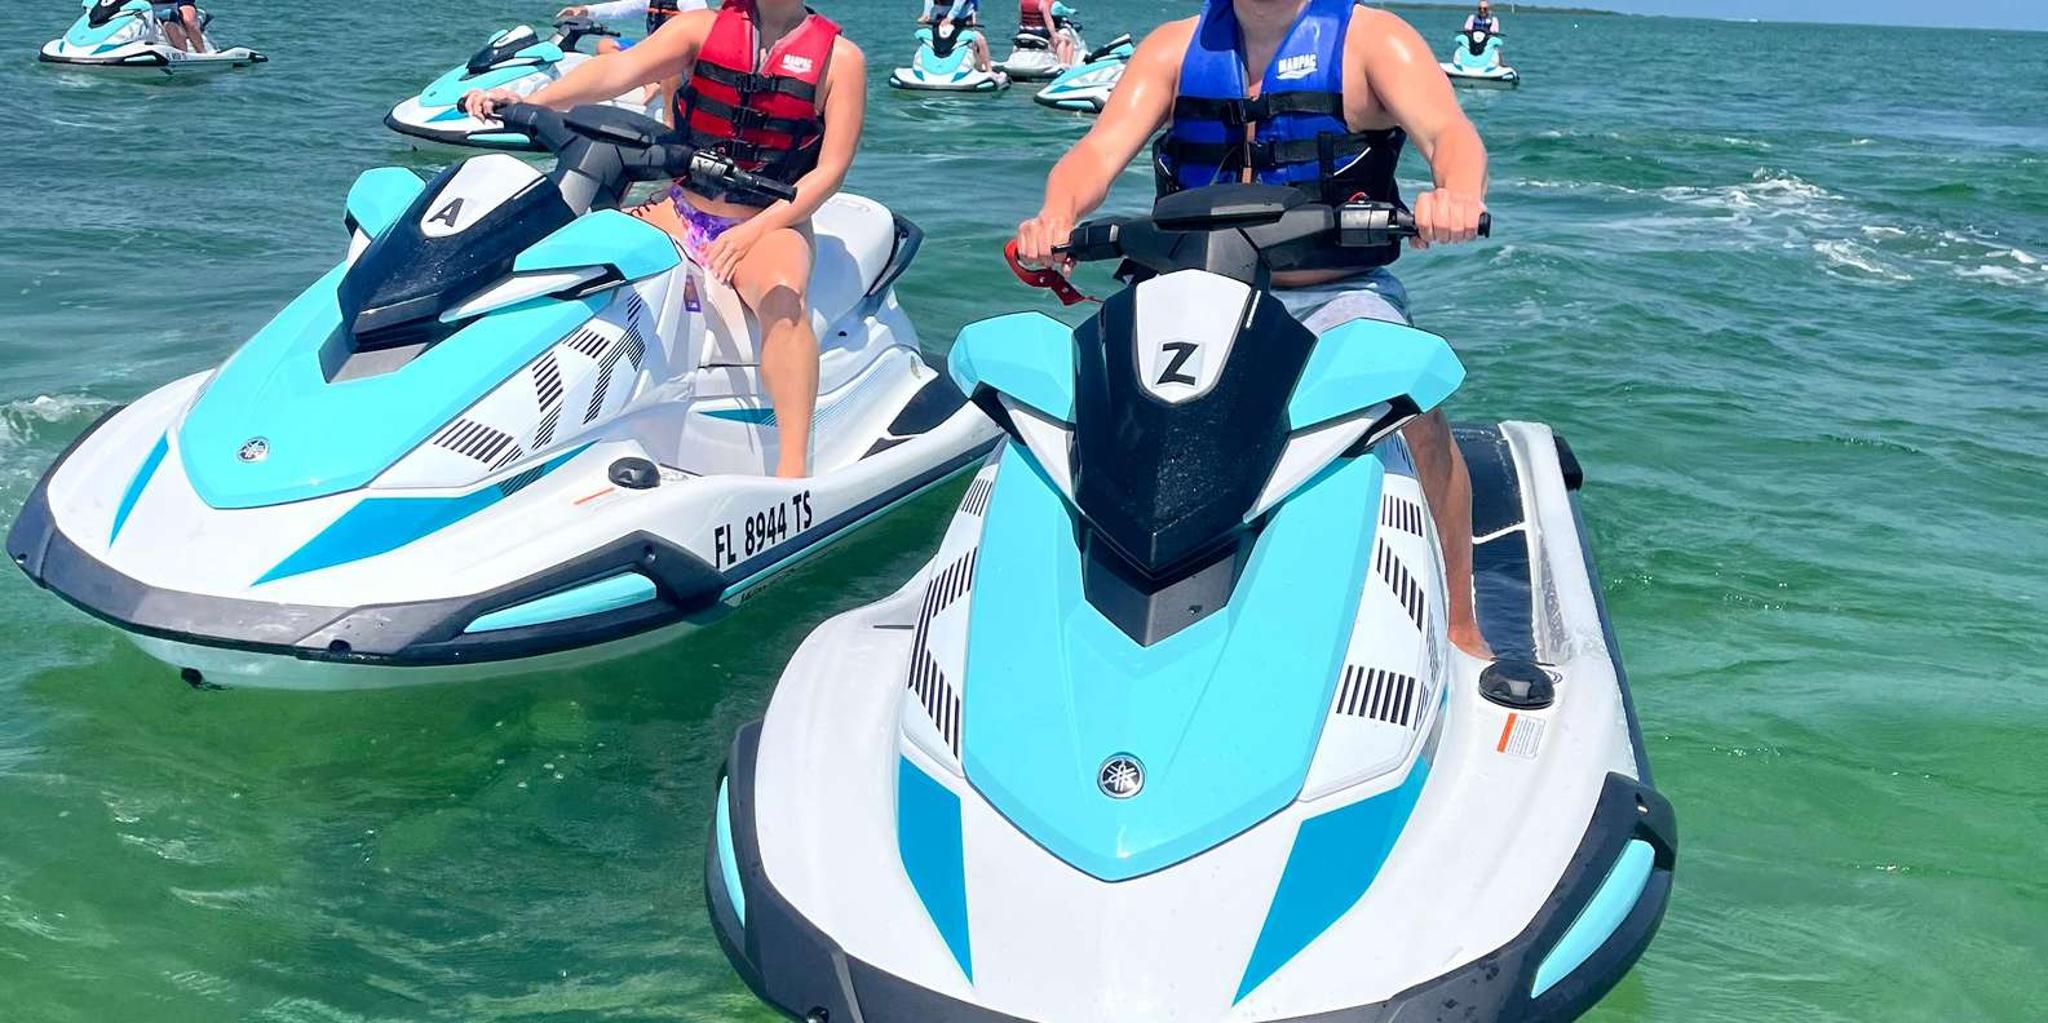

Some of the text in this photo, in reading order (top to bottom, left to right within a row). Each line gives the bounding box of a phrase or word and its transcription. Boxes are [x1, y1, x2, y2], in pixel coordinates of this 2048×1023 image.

[427, 197, 465, 228] A
[1155, 341, 1199, 386] Z
[714, 490, 812, 569] FL 8944 TS
